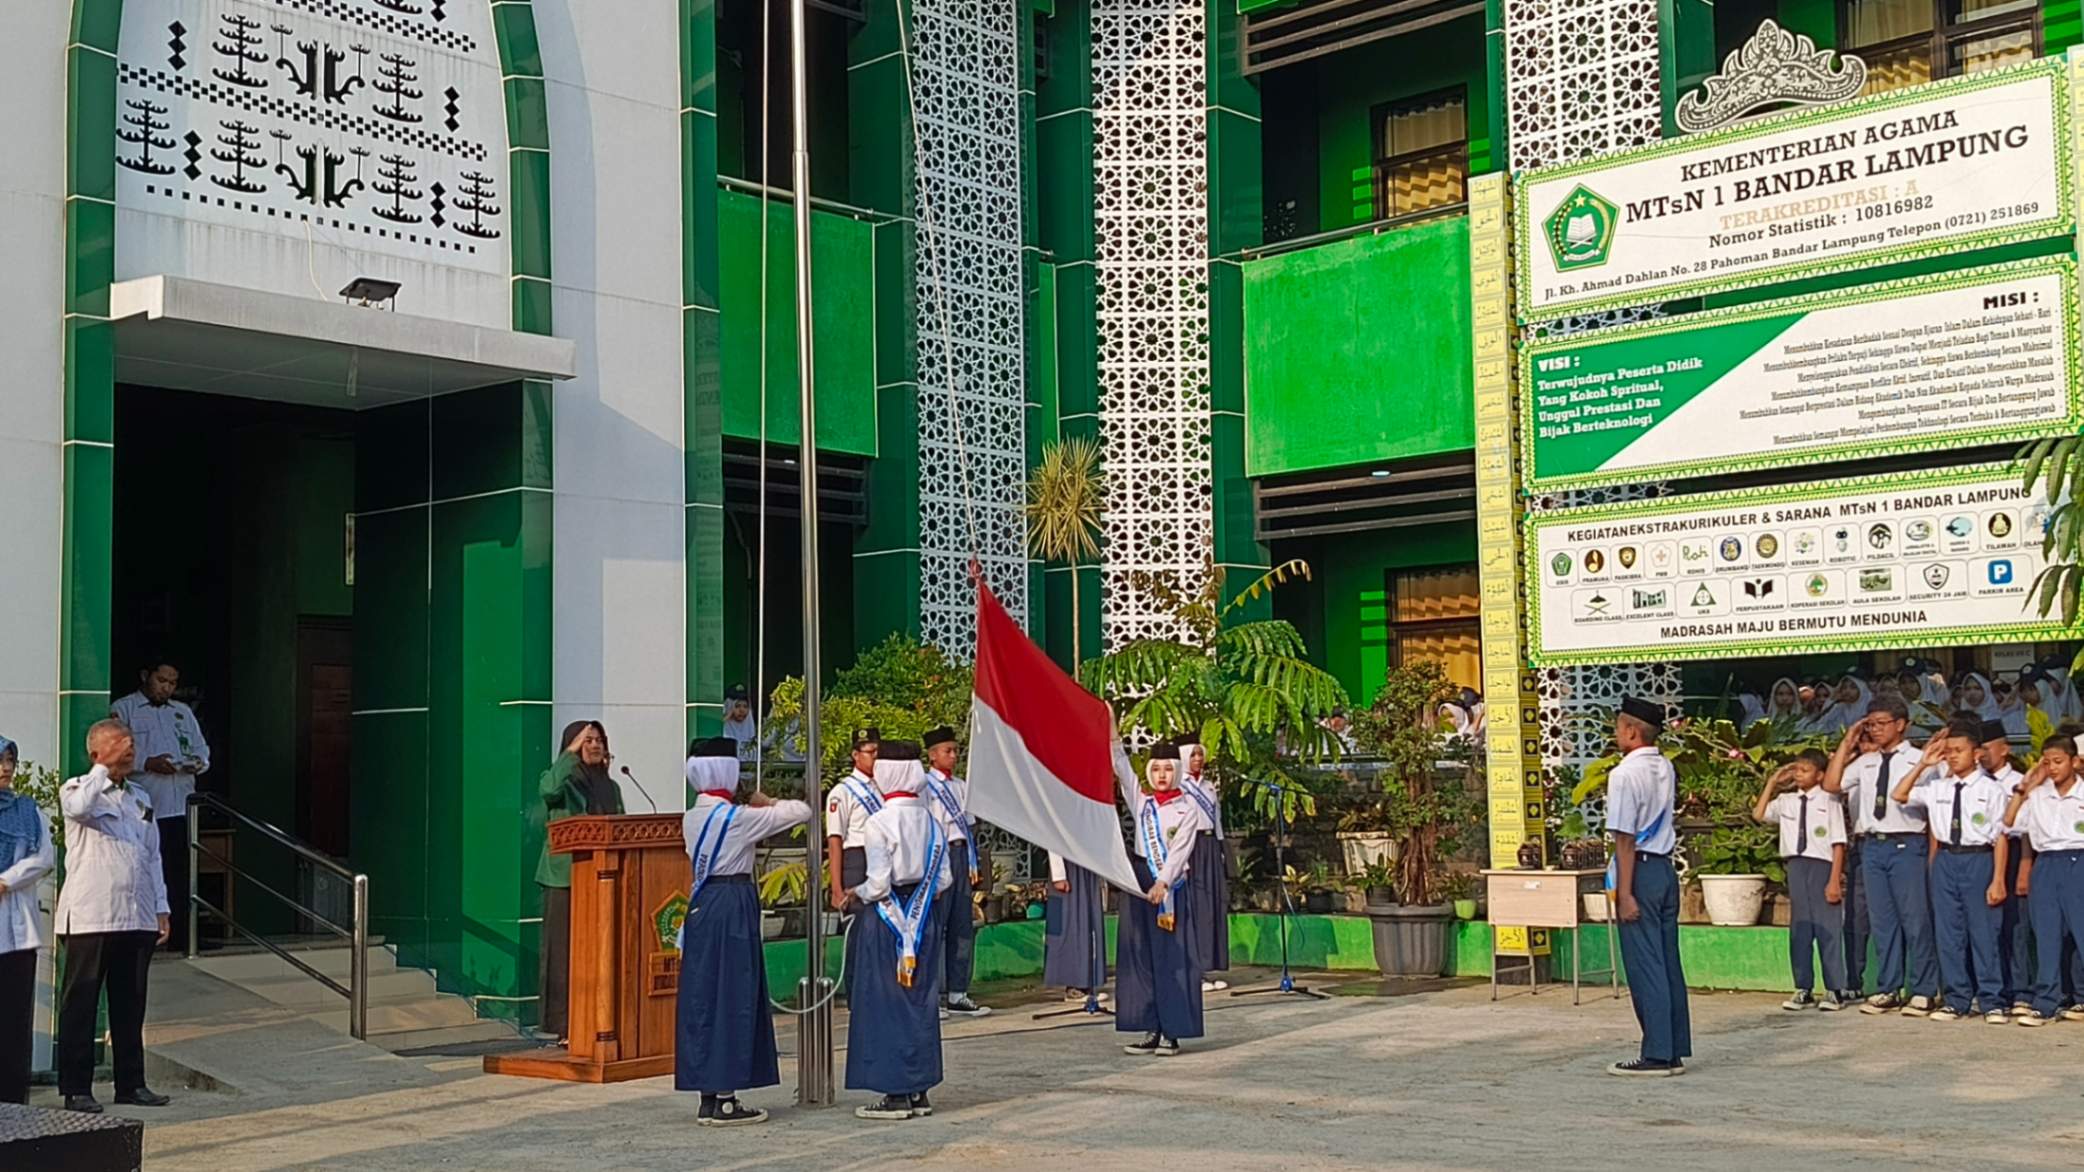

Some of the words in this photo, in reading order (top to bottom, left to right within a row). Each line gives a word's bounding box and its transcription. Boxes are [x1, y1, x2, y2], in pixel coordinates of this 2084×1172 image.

[1681, 130, 1855, 181] KEMENTERIAN
[1863, 109, 1958, 145] AGAMA
[1626, 188, 1704, 223] MTsN
[1713, 185, 1724, 206] 1
[1734, 159, 1856, 202] BANDAR
[1865, 125, 2027, 176] LAMPUNG
[1720, 185, 1886, 229] TERAKREDITASI
[1905, 179, 1918, 196] A
[1708, 229, 1764, 248] Nomor
[1768, 213, 1836, 237] Statistik
[1856, 195, 1933, 221] 10816982
[1544, 287, 1557, 301] Jl.
[1559, 284, 1579, 296] Kh.
[1581, 275, 1622, 292] Ahmad
[1625, 270, 1667, 284] Dahlan
[1670, 264, 1690, 276] No.
[1693, 260, 1707, 272] 28
[1710, 252, 1768, 269] Pahoman
[1771, 243, 1818, 259] Bandar
[1821, 231, 1884, 250] Lampung
[1886, 221, 1941, 238] Telepon
[1944, 211, 1986, 229] (0721)
[1990, 201, 2039, 220] 251869
[1983, 291, 2026, 310] MISI
[1537, 372, 1615, 390] Terwujudnya
[1617, 365, 1664, 379] Peserta
[1666, 357, 1702, 372] Didik
[1538, 355, 1570, 372] VISI
[1537, 395, 1567, 406] Yang
[1569, 387, 1608, 402] Kokoh
[1610, 379, 1663, 398] Spritual,
[1538, 406, 1580, 422] Unggul
[1583, 400, 1633, 416] Prestasi
[1635, 397, 1661, 409] Dan
[1539, 424, 1570, 438] Bijak
[1573, 414, 1652, 433] Berteknologi
[1775, 506, 1831, 522] SARANA
[1839, 501, 1876, 516] MTsN
[1881, 499, 1888, 512] 1
[1893, 493, 1953, 511] BANDAR
[1660, 623, 1733, 638] MADRASAH
[1736, 620, 1774, 633] MAJU
[1778, 615, 1846, 631] BERMUTU
[1850, 610, 1927, 626] MENDUNIA
